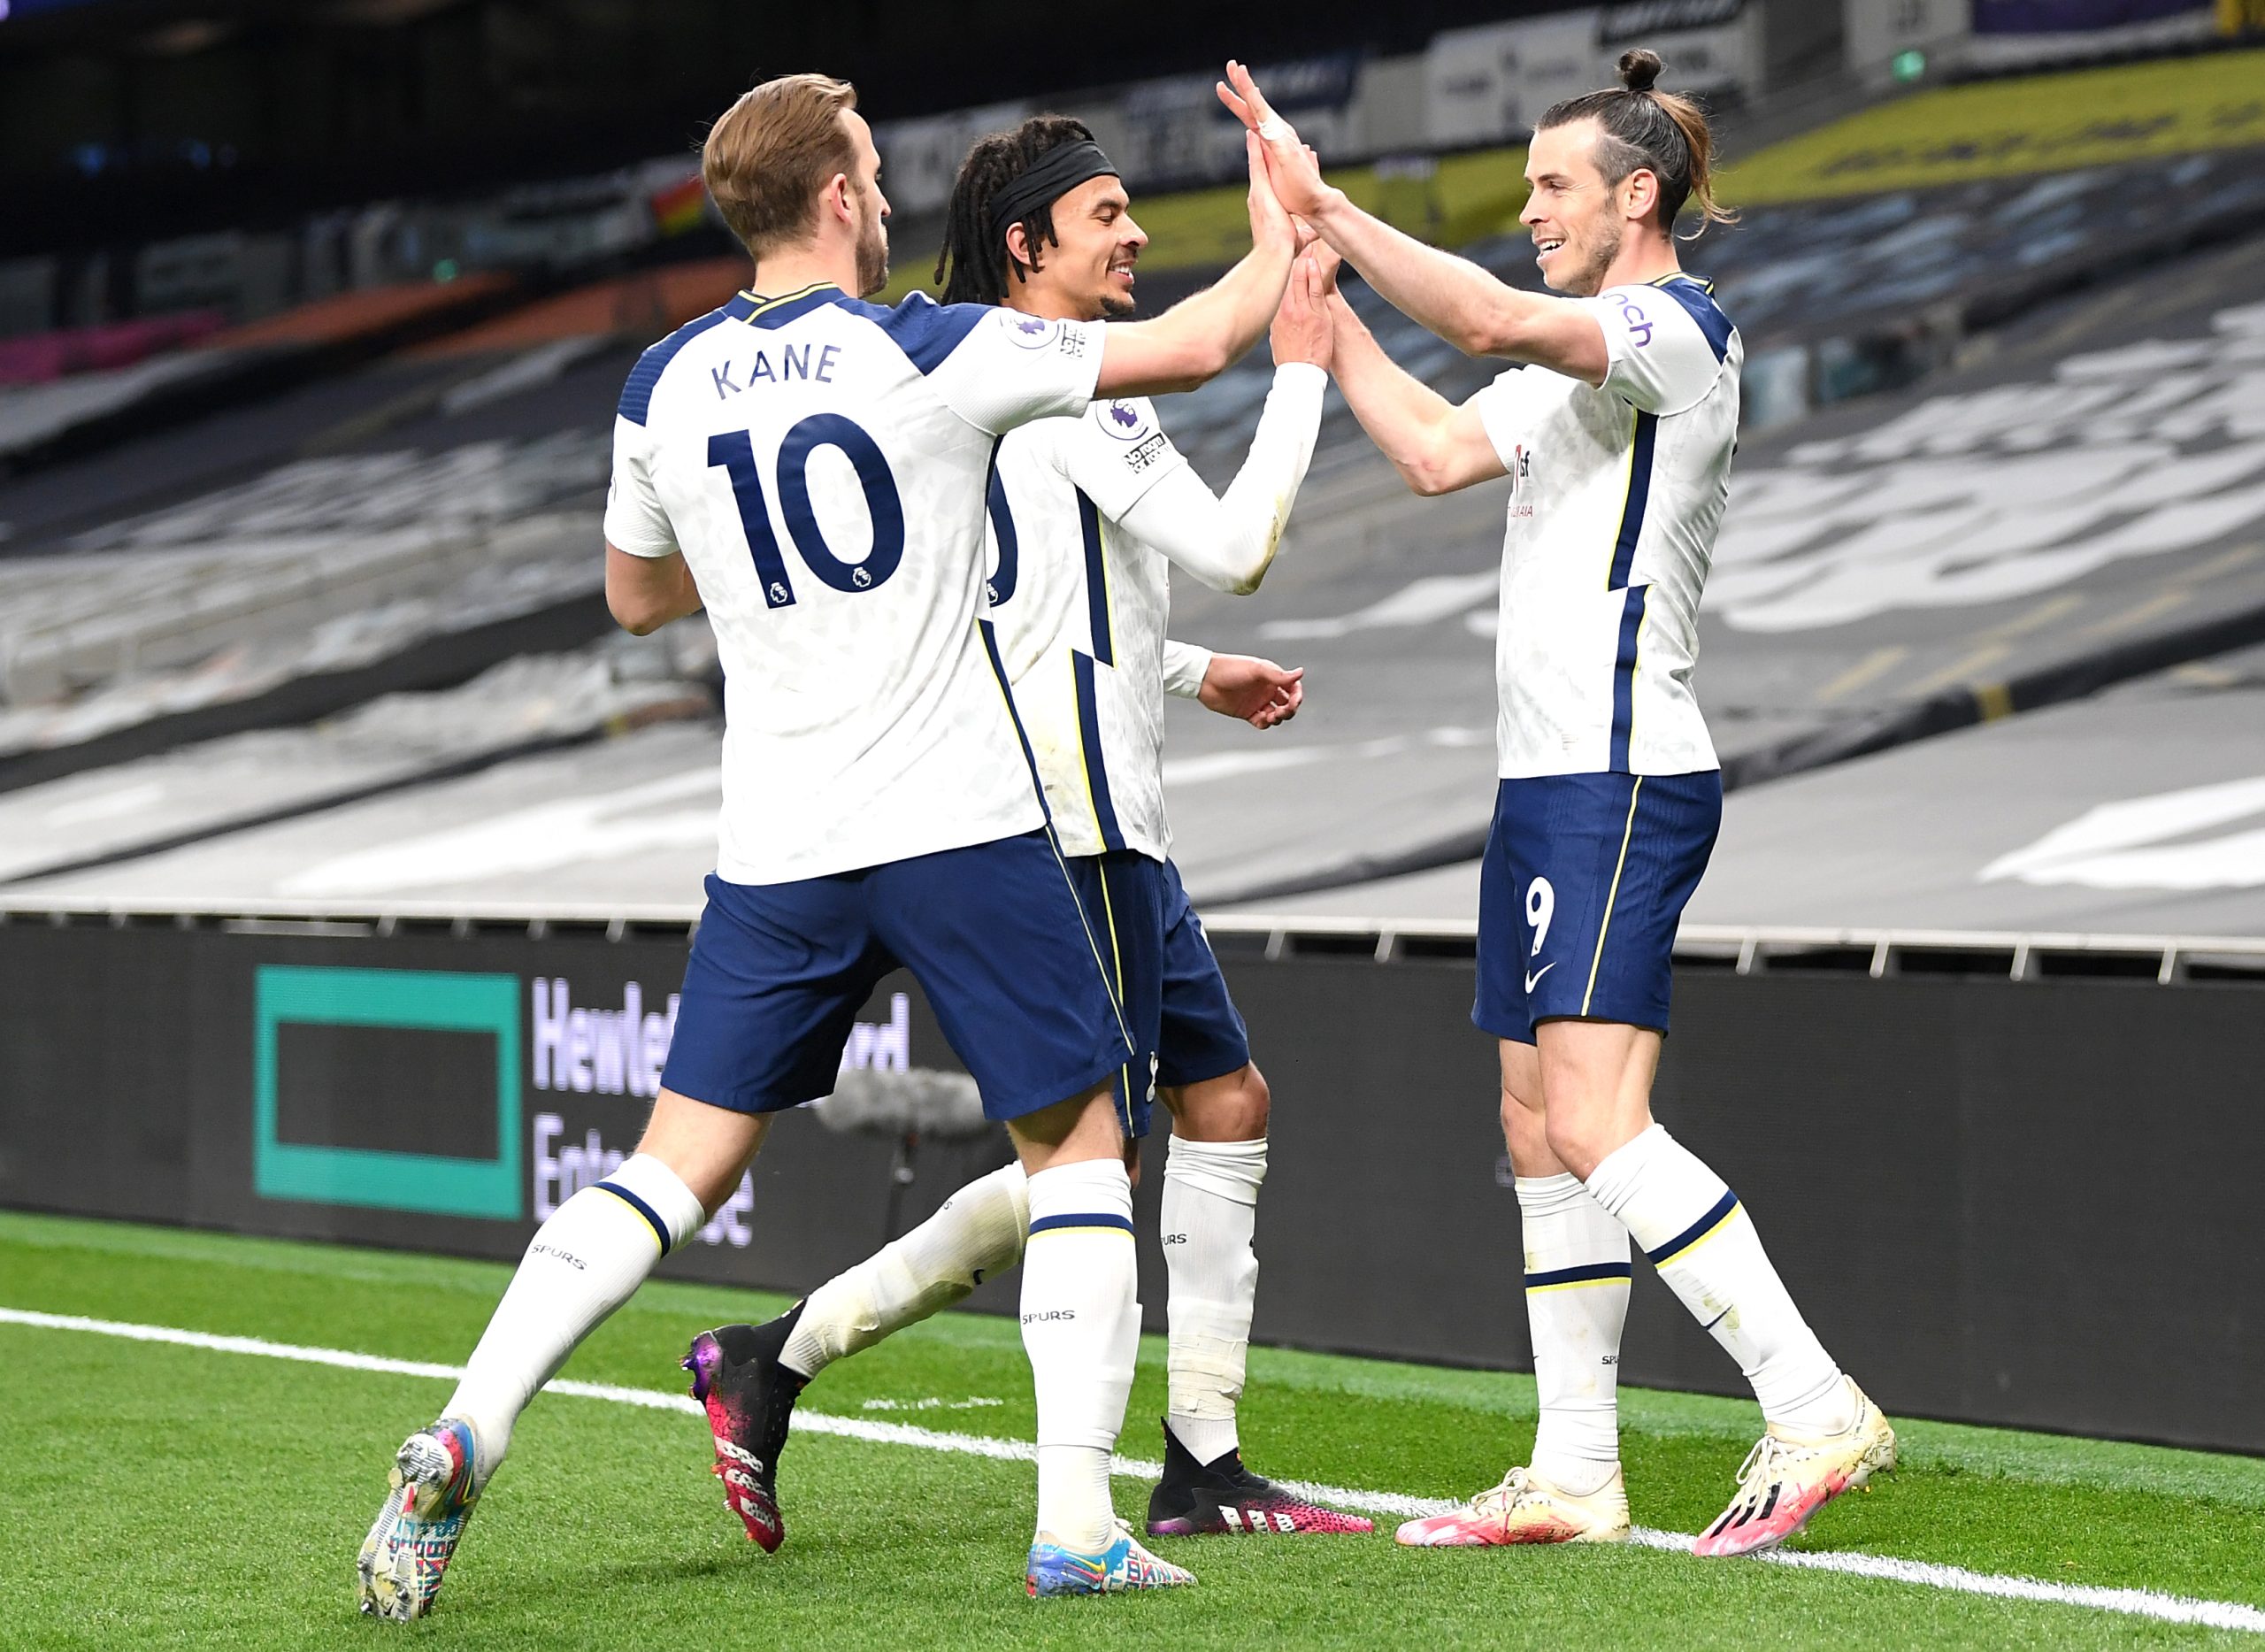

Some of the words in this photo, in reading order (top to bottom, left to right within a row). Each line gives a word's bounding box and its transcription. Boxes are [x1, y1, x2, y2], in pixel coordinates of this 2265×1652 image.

[1602, 293, 1653, 348] nch
[711, 343, 841, 401] KANE
[1122, 448, 1143, 467] No
[708, 413, 905, 609] 10
[1525, 876, 1555, 957] 9
[533, 977, 680, 1097] Hewle
[531, 1244, 587, 1271] SPURS
[1161, 1233, 1187, 1246] URS
[1022, 1310, 1076, 1325] SPURS
[1601, 1355, 1619, 1364] SPU
